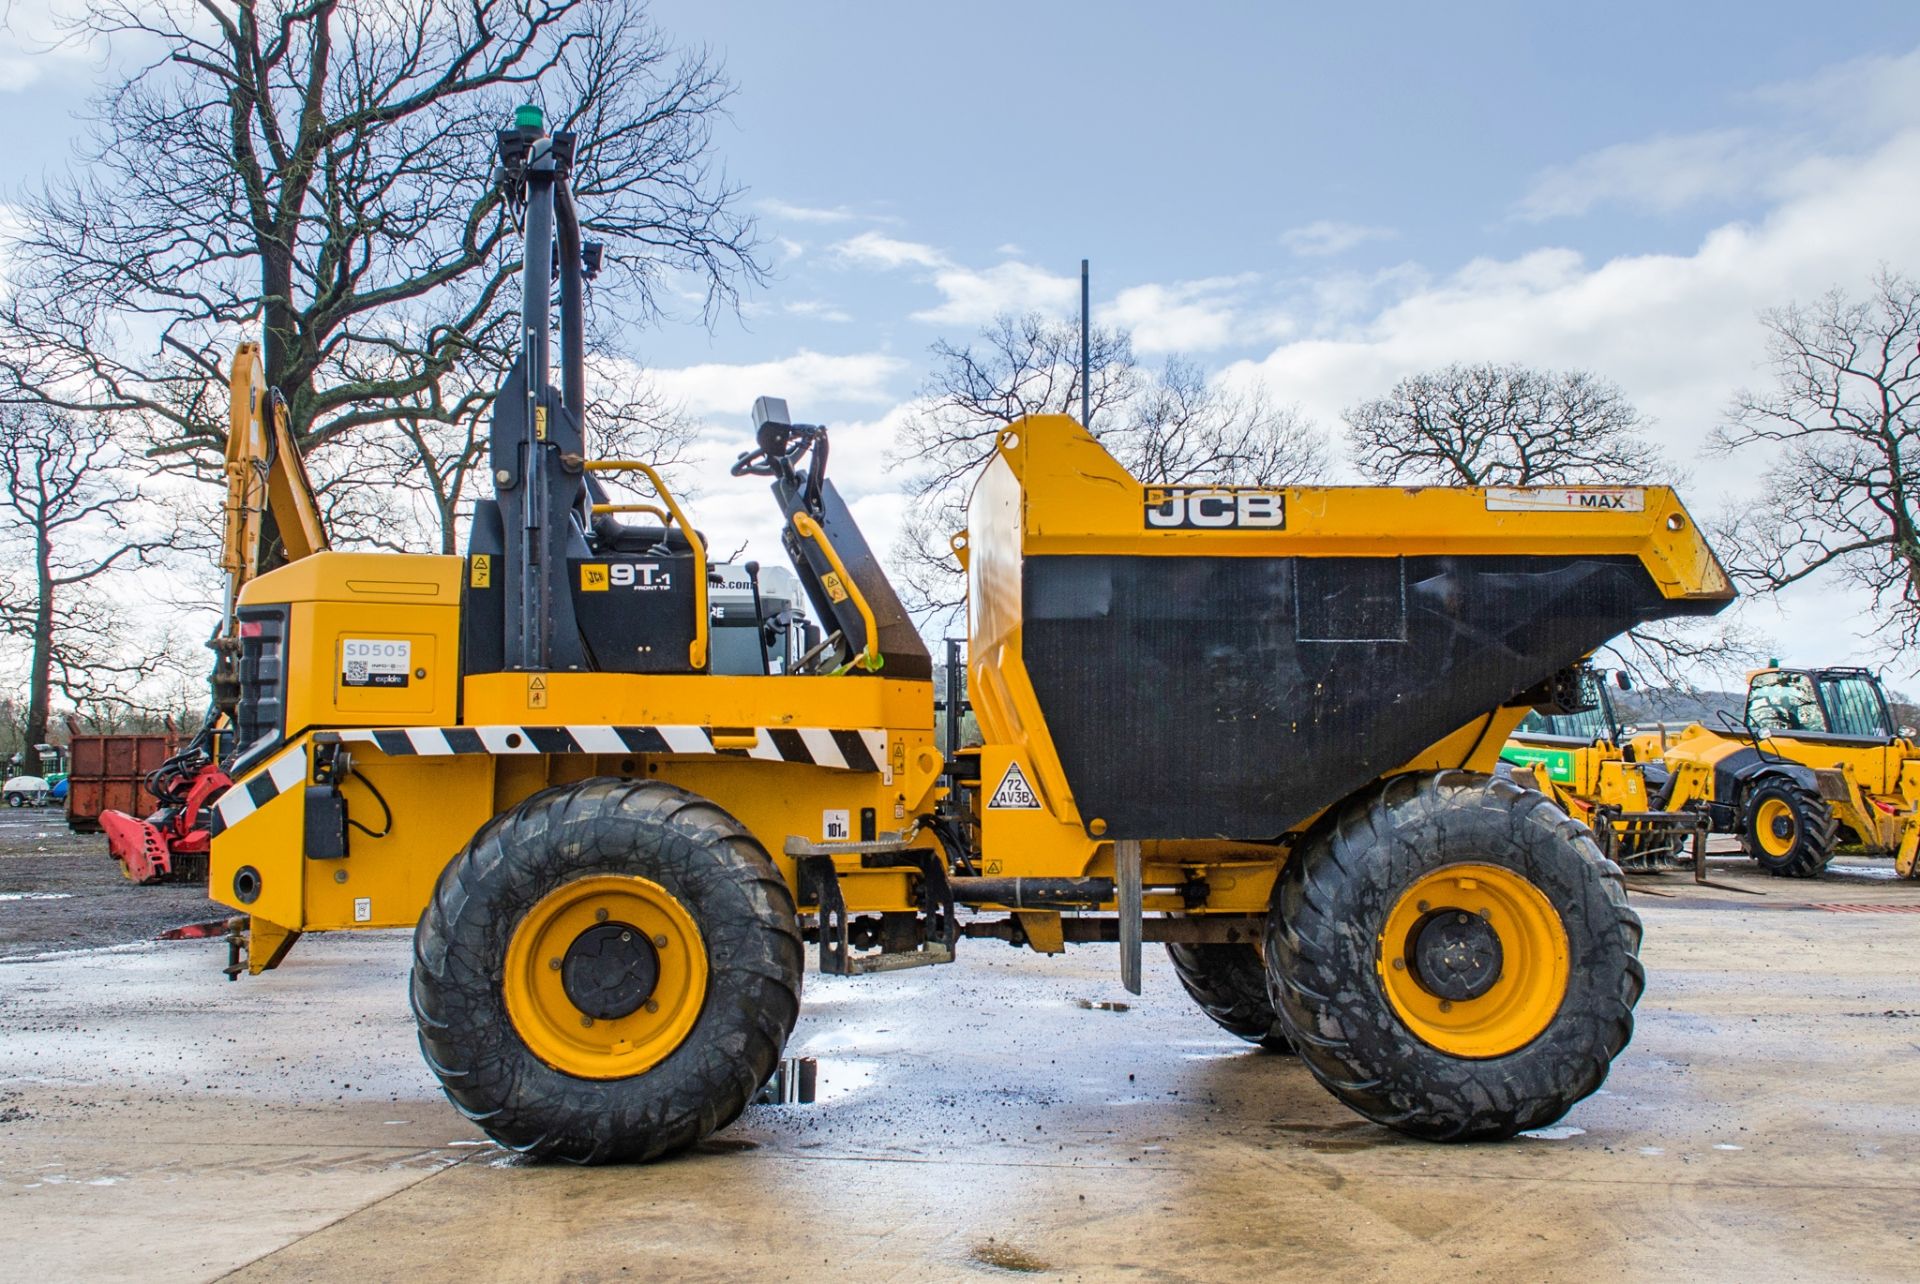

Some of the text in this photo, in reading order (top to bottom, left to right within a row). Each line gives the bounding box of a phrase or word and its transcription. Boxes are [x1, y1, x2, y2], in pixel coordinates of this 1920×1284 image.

[1148, 489, 1283, 526] JCB
[1580, 495, 1625, 509] MAX
[346, 643, 407, 657] SD505
[1007, 779, 1022, 791] 72
[1000, 791, 1030, 803] AV3B
